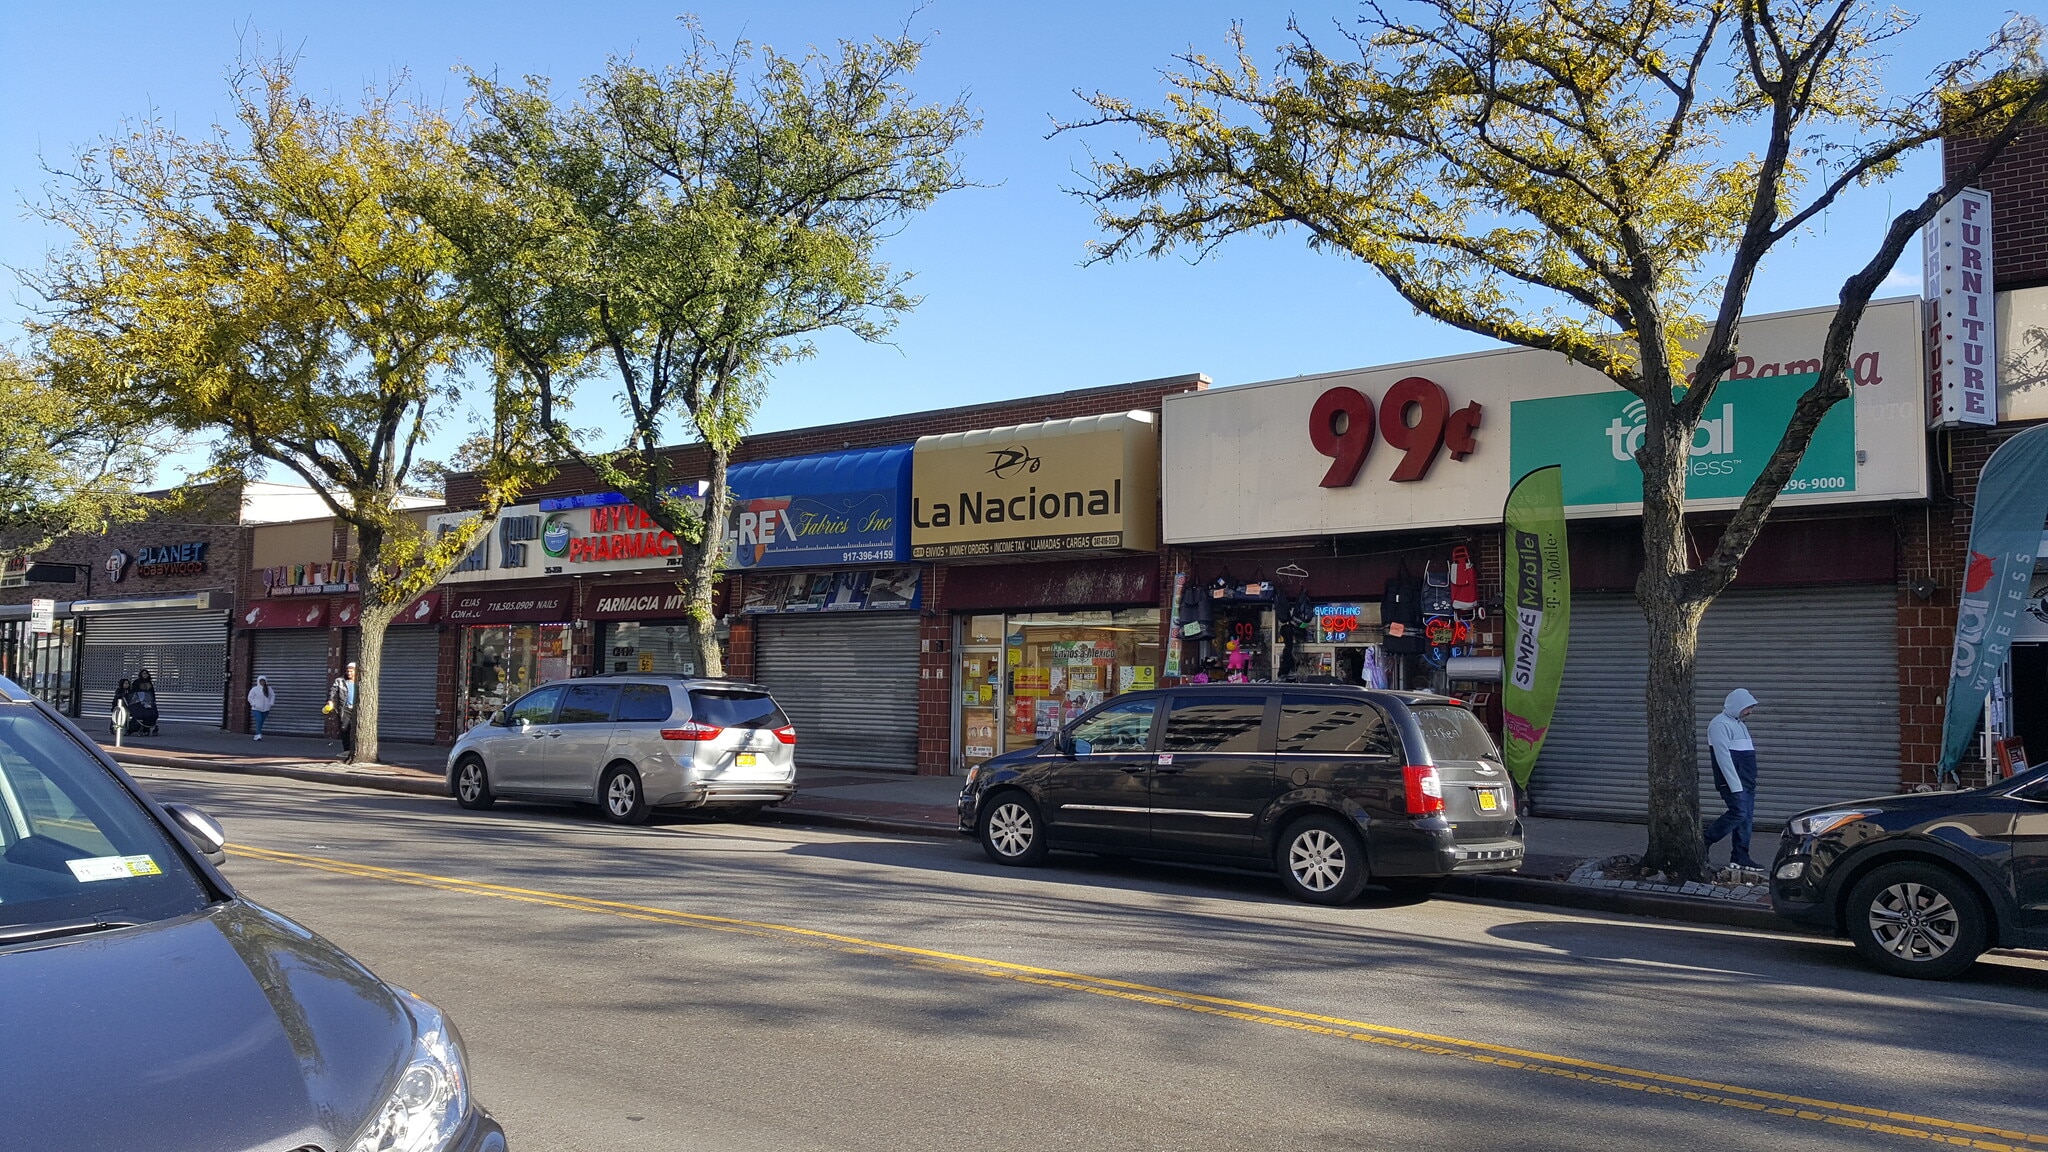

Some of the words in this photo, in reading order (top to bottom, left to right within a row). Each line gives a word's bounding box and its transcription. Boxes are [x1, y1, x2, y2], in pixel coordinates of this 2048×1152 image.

[1961, 199, 1985, 414] FURNITURE
[1309, 376, 1482, 488] 99¢
[913, 497, 950, 528] La
[959, 479, 1121, 525] Nacional
[795, 512, 849, 537] Fabrics
[857, 508, 893, 533] Inc
[137, 543, 204, 565] PLANET
[569, 529, 683, 562] PHARMAC
[842, 550, 894, 562] 917-396-4159
[926, 546, 945, 557] ENVIOS
[949, 544, 967, 555] MONEY
[968, 543, 990, 554] ORDERS
[994, 540, 1015, 553] INCOME
[1015, 539, 1026, 551] TAX
[1030, 538, 1060, 550] LLAMADAS
[1066, 536, 1090, 549] CARGAS
[1521, 537, 1538, 606] Mobile
[536, 600, 559, 609] NAILS
[596, 596, 660, 612] FARMACIA
[1314, 606, 1361, 616] EVERYTHING
[1236, 623, 1253, 640] 99
[1974, 552, 2031, 691] WIRELESS
[1326, 632, 1332, 641] &
[1515, 611, 1537, 685] SIMPLE
